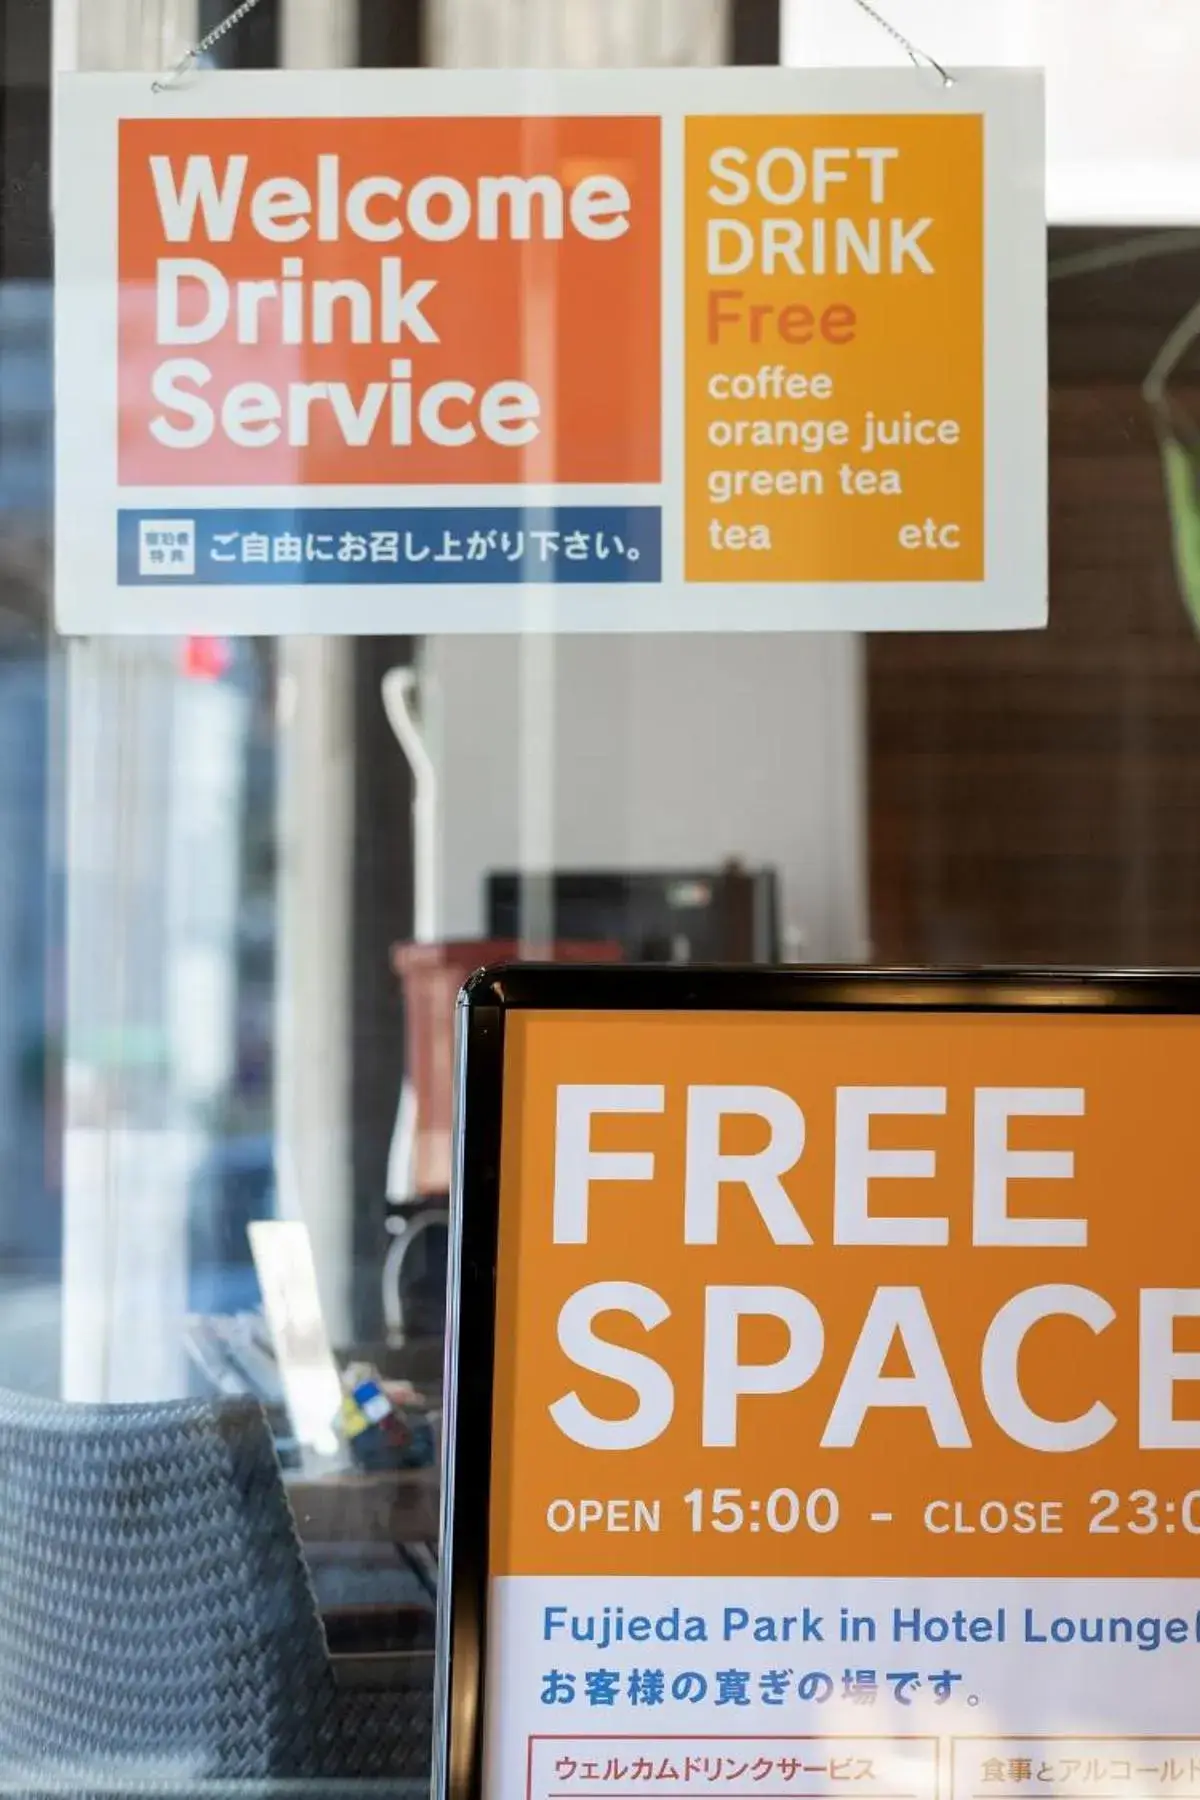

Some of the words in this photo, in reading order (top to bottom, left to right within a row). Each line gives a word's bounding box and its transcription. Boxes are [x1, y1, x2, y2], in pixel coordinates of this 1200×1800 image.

[149, 153, 631, 242] Welcome
[708, 146, 898, 206] SOFT
[707, 217, 935, 276] DRINK
[156, 257, 440, 344] Drink
[707, 289, 857, 345] Free
[148, 358, 541, 448] Service
[708, 365, 833, 399] coffee
[708, 418, 849, 453] orange
[861, 412, 960, 452] juice
[708, 465, 823, 502] green
[839, 463, 902, 495] tea
[210, 530, 640, 563] ご自由にお召し上がり下さい。
[708, 520, 771, 550] tea
[899, 518, 961, 549] etc
[553, 1084, 1088, 1248] FREE
[547, 1499, 660, 1533] OPEN
[683, 1487, 839, 1533] 15:00
[923, 1499, 1062, 1534] CLOSE
[543, 1606, 707, 1649] Fujieda
[723, 1607, 824, 1642] Park
[840, 1608, 876, 1642] in
[893, 1607, 1005, 1643] Hotel
[540, 1667, 979, 1706] お客様の寛ぎの場です。
[555, 1756, 876, 1782] ウェルカムドリンクサービス
